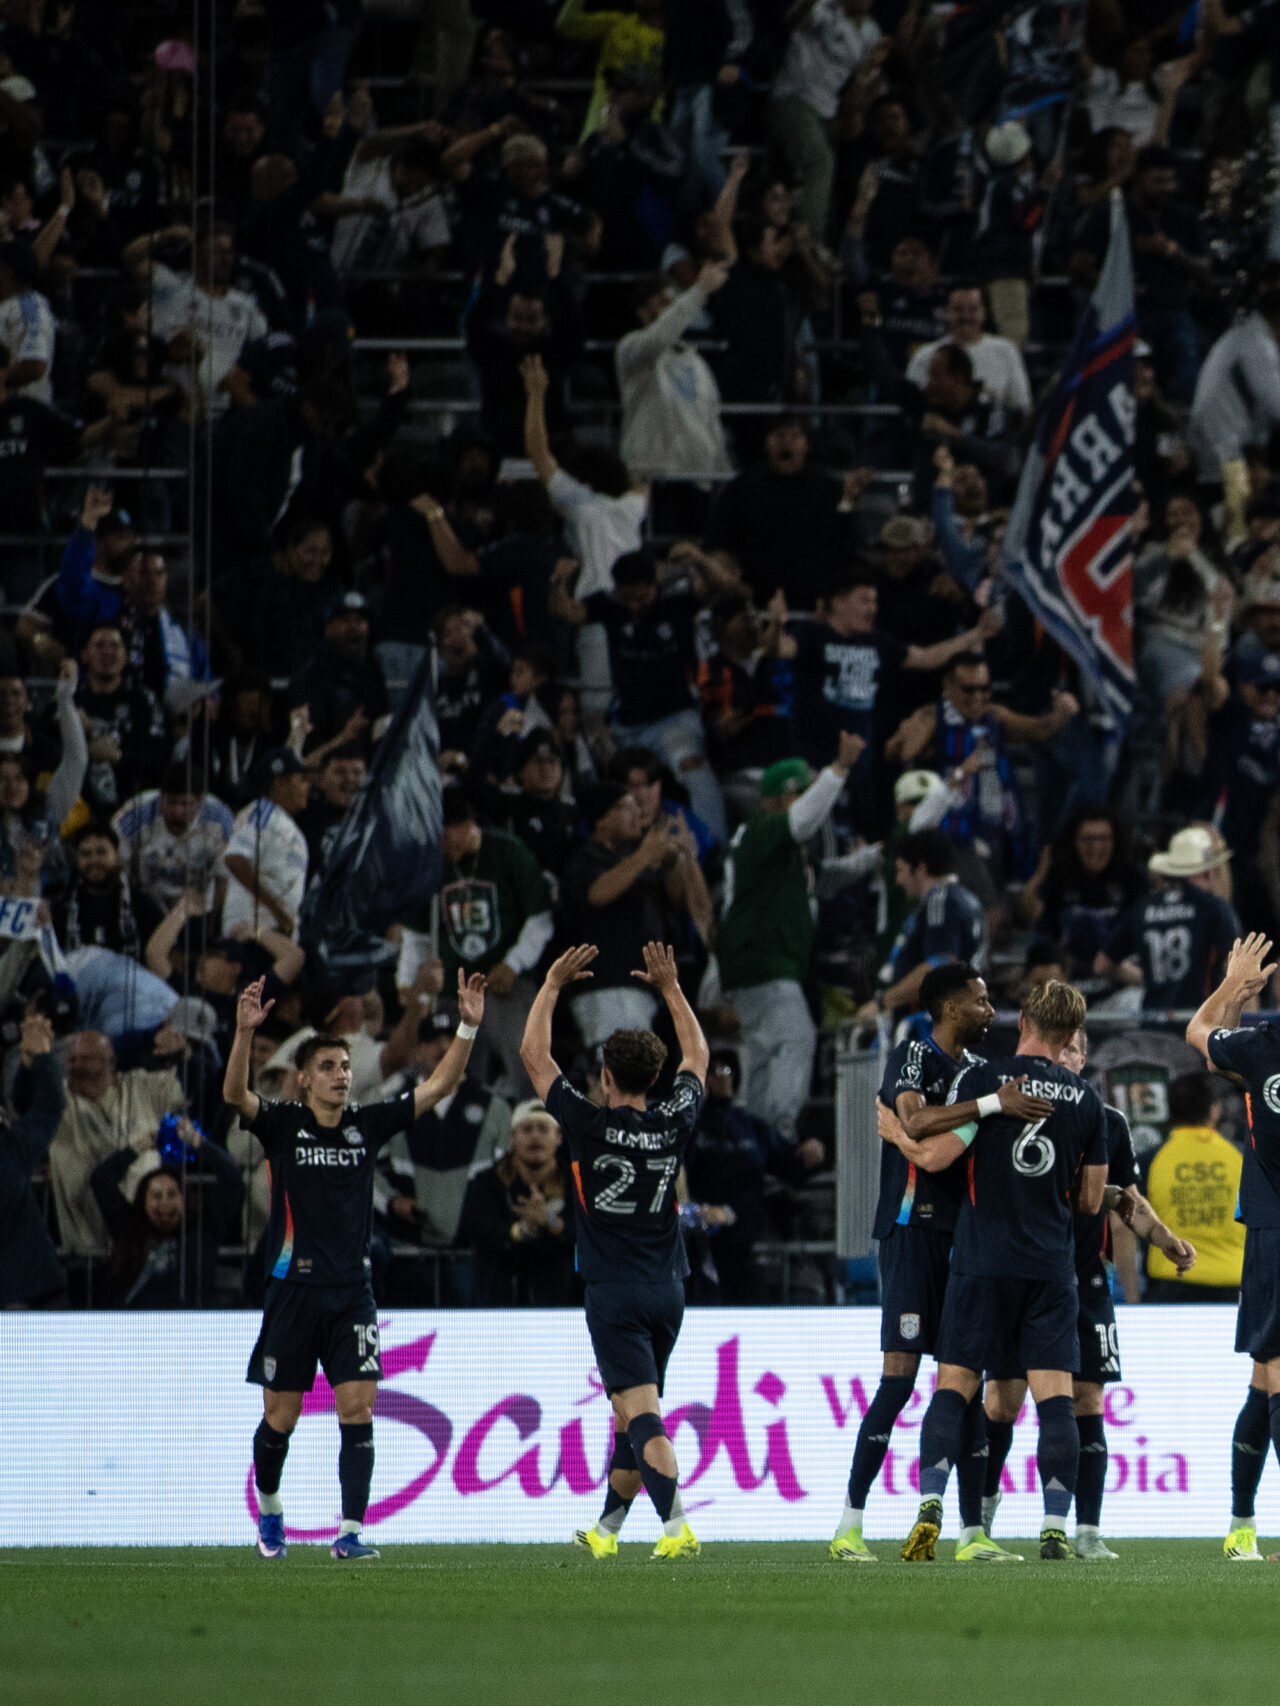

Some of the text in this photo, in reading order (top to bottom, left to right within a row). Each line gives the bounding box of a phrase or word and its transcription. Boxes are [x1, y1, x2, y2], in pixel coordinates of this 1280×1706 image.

[1143, 926, 1193, 984] 18
[997, 1073, 1085, 1105] TERSKOV
[1012, 1117, 1057, 1178] 6
[592, 1153, 679, 1215] 27
[1174, 1161, 1227, 1183] CSC
[353, 1323, 380, 1357] 19
